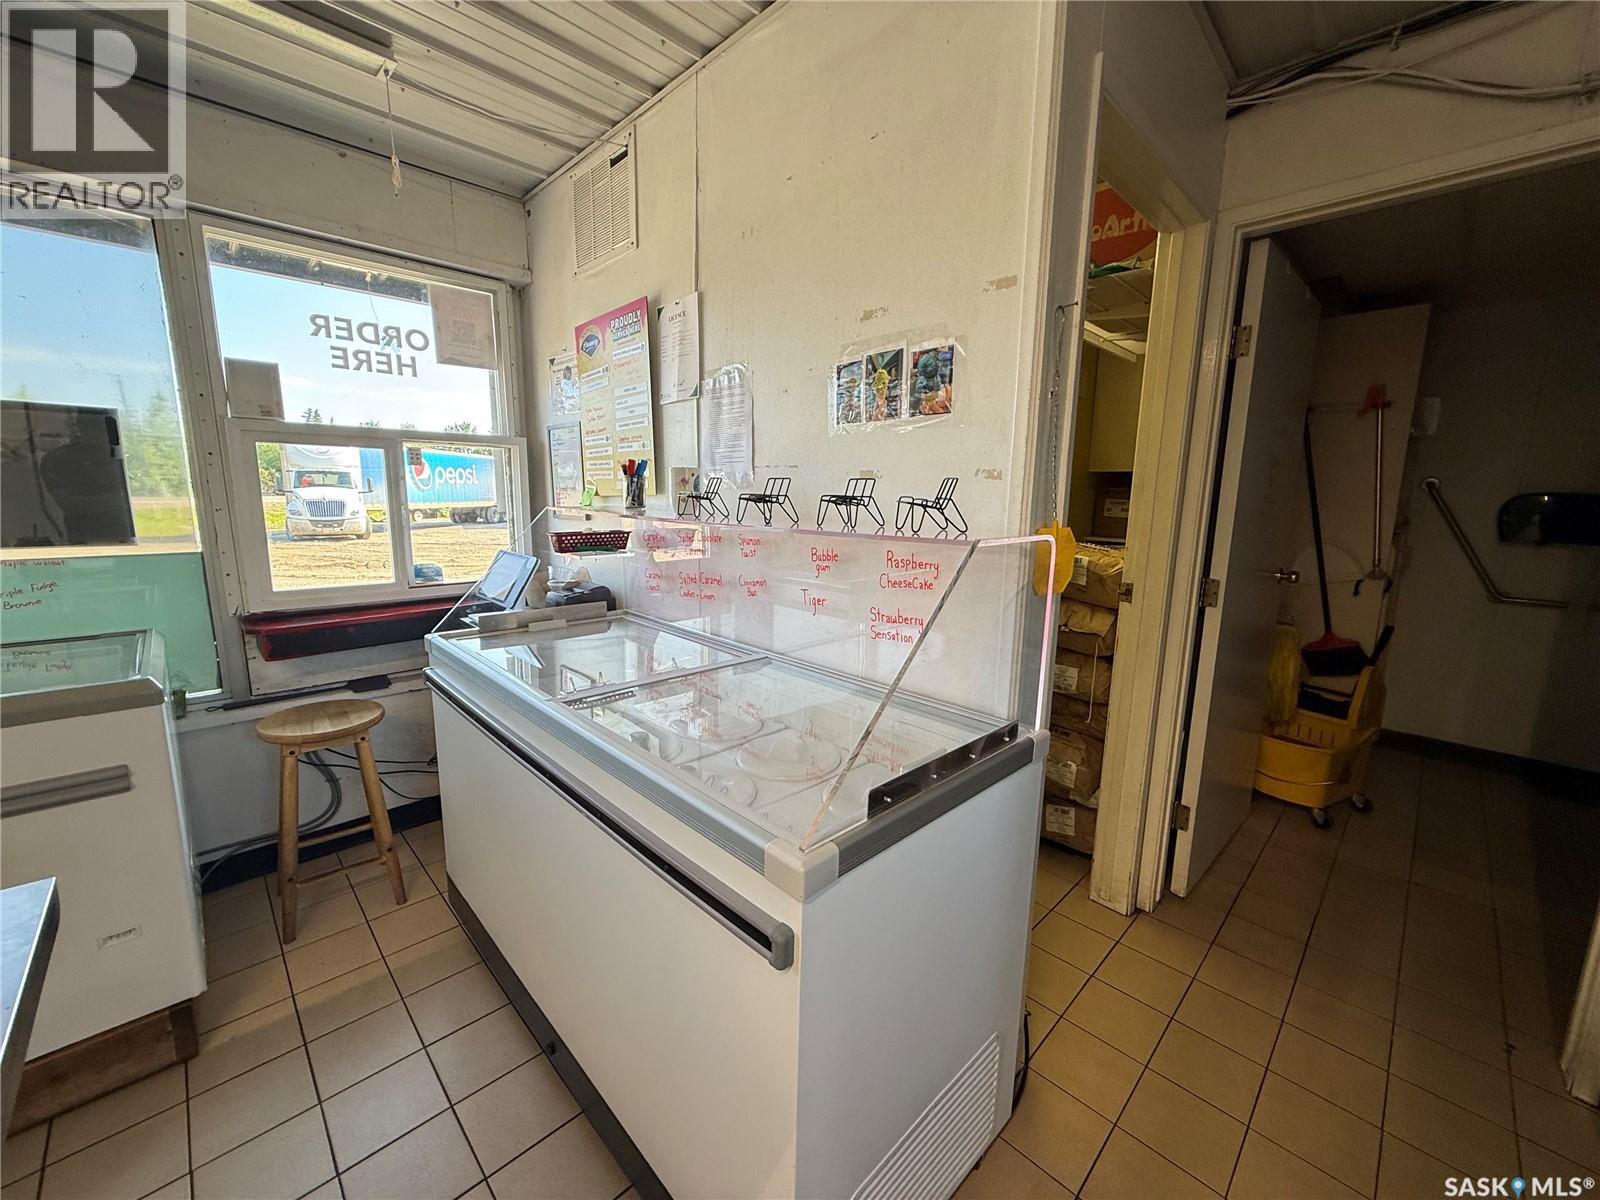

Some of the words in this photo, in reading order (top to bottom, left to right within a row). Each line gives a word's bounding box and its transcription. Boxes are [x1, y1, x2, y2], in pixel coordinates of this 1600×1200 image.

[610, 309, 641, 330] PROUDLY
[434, 463, 479, 486] pepsi
[810, 547, 839, 562] Bubble
[815, 563, 831, 578] gum
[886, 550, 940, 580] Raspberry
[700, 571, 724, 586] Caramel
[738, 575, 768, 588] Cinnamon
[800, 588, 827, 616] Tiger
[869, 606, 924, 635] Strawberry
[870, 625, 914, 645] Sensation
